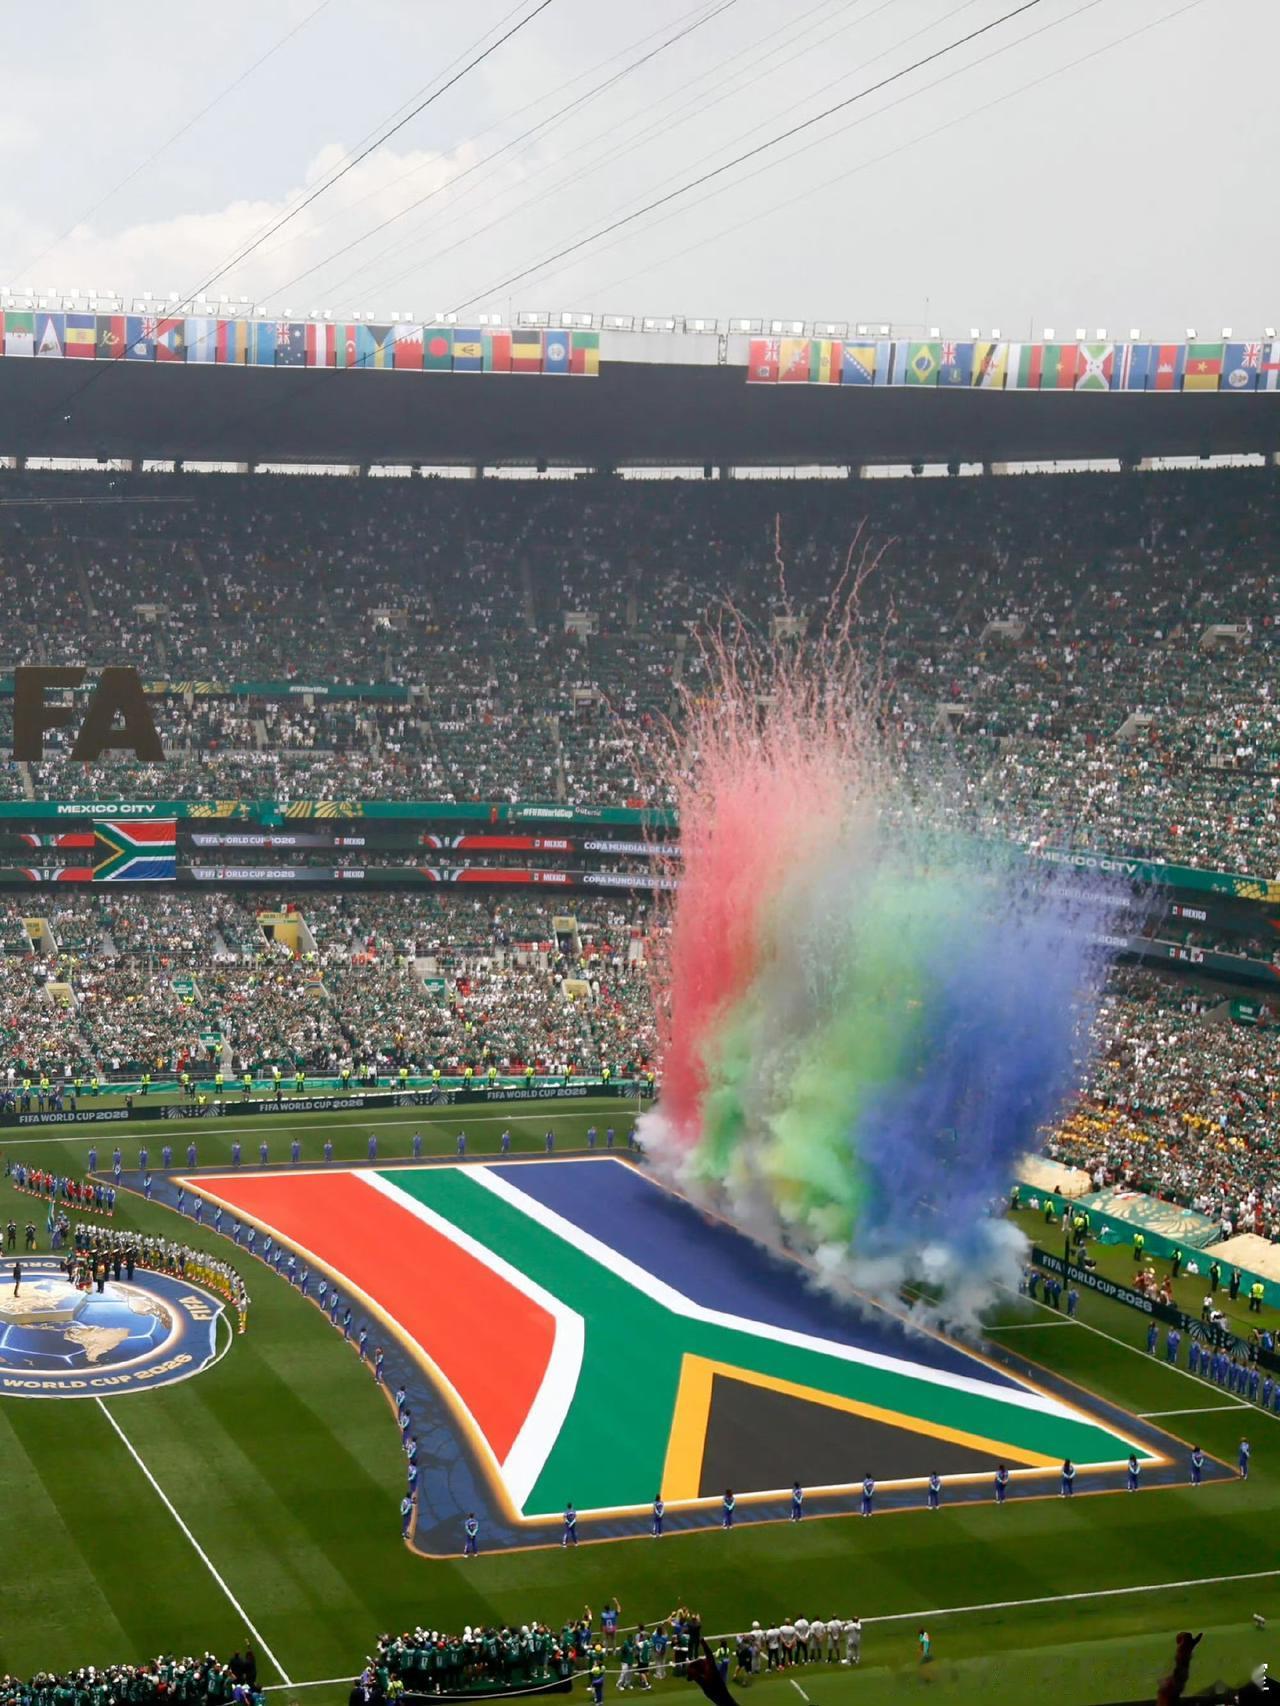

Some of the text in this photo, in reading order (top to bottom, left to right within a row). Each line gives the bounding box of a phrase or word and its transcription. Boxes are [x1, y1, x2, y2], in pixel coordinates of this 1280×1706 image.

[13, 666, 166, 762] FA
[57, 804, 156, 813] MEXICO CITY
[584, 842, 608, 850] COPA
[609, 843, 647, 853] MUNDIAL
[1042, 852, 1136, 873] MEXICO CITY
[608, 877, 647, 886] MUNDIAL
[1183, 908, 1206, 920] MEXICO
[487, 1087, 587, 1099] FIFA WORLD CUP 2026
[260, 1103, 279, 1111] FIFA
[281, 1102, 312, 1110] WORLD
[332, 1099, 364, 1108] 2026
[20, 1110, 129, 1123] FIFA WORLD CUP 2026
[1042, 1255, 1062, 1272] FIFA
[1096, 1280, 1116, 1295] CUP
[1117, 1289, 1152, 1312] 2026
[178, 1295, 214, 1321] FIFA
[3, 1353, 193, 1389] WORLD CUP 2026
